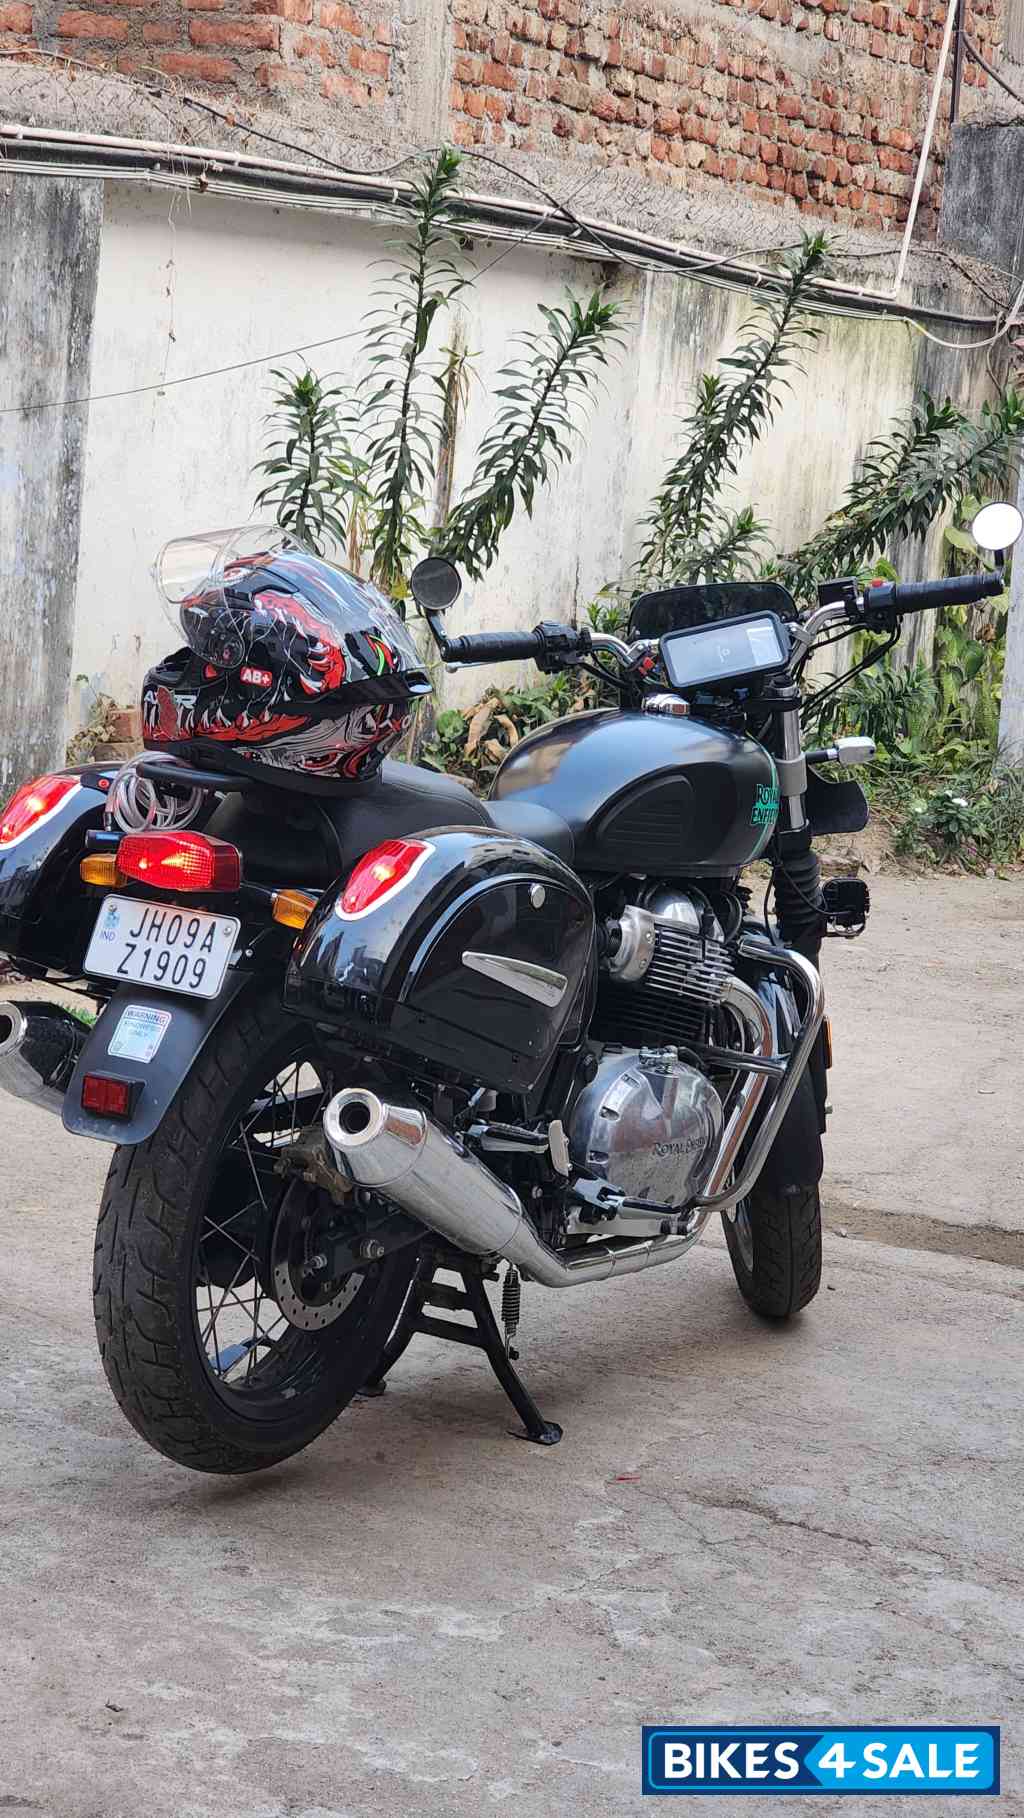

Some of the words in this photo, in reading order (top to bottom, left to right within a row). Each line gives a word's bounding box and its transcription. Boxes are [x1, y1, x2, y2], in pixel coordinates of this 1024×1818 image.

[242, 667, 270, 685] AB+
[130, 907, 217, 953] JH09A
[116, 943, 207, 989] Z1909
